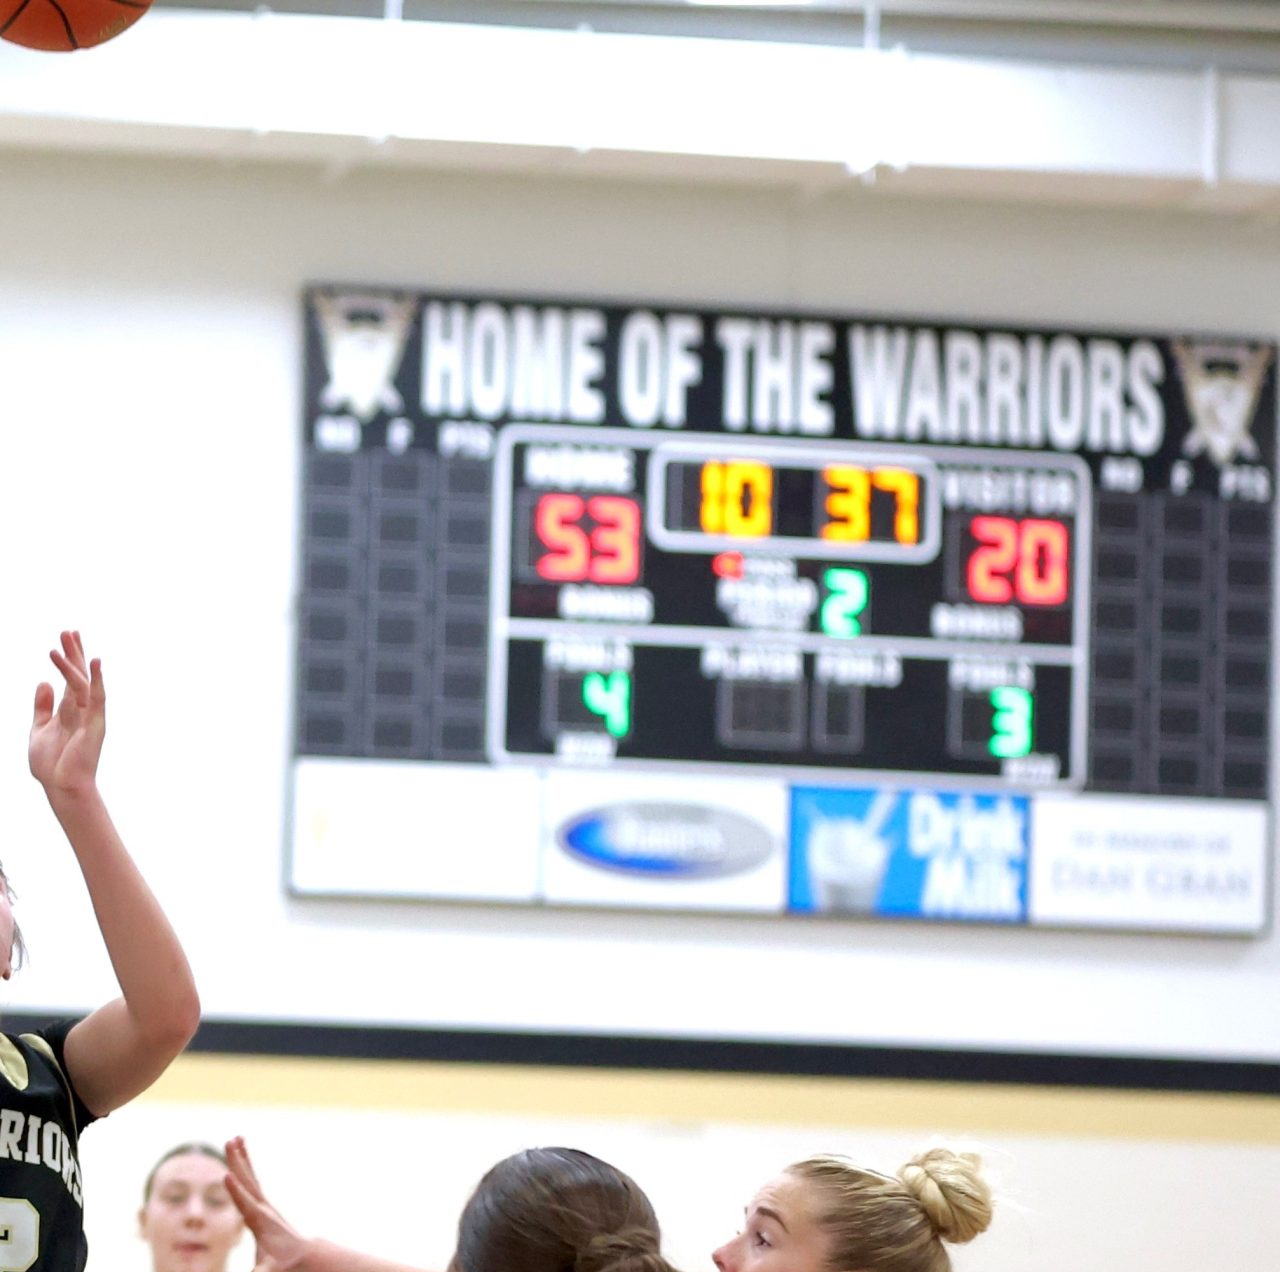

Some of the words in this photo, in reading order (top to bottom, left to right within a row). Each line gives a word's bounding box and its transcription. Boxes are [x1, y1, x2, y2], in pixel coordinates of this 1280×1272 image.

[422, 302, 607, 424] HOME
[619, 308, 704, 428] OF
[716, 318, 835, 438] THE
[848, 322, 1166, 456] WARRIORS
[534, 492, 642, 584] 53
[699, 459, 775, 538] 10
[821, 463, 920, 548] 37
[966, 514, 1068, 606] 20
[820, 567, 869, 640] 2
[581, 670, 632, 738] 4
[987, 685, 1035, 759] 3
[907, 792, 1025, 858] Drink
[922, 852, 1024, 917] Milk
